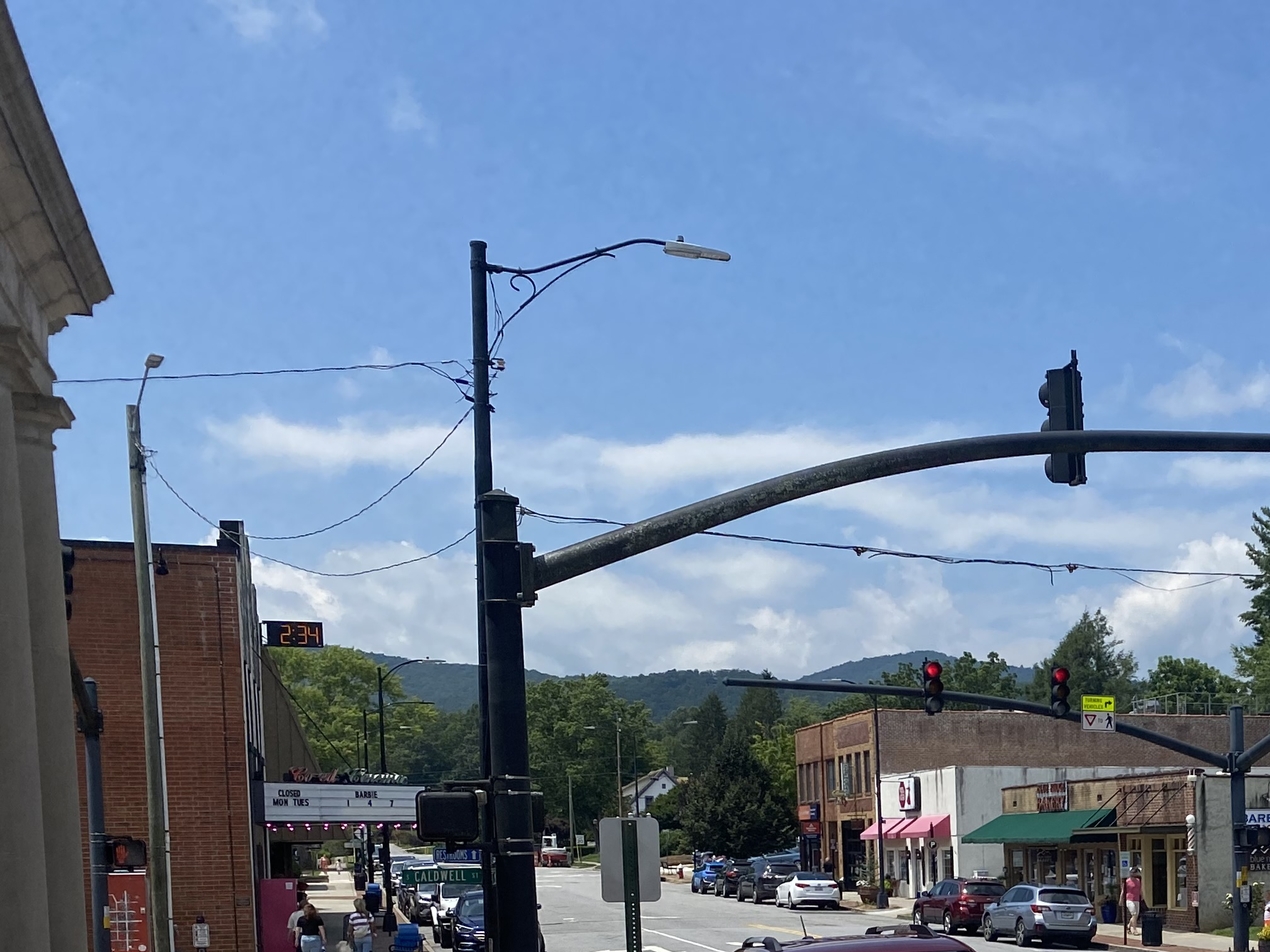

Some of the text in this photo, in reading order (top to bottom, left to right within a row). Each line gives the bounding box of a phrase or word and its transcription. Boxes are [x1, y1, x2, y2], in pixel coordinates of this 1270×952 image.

[280, 624, 319, 645] 2:34
[278, 789, 301, 798] CLOSED
[355, 790, 378, 799] BARBIE
[273, 798, 310, 807] MON TUES
[414, 870, 467, 882] CALDWELL
